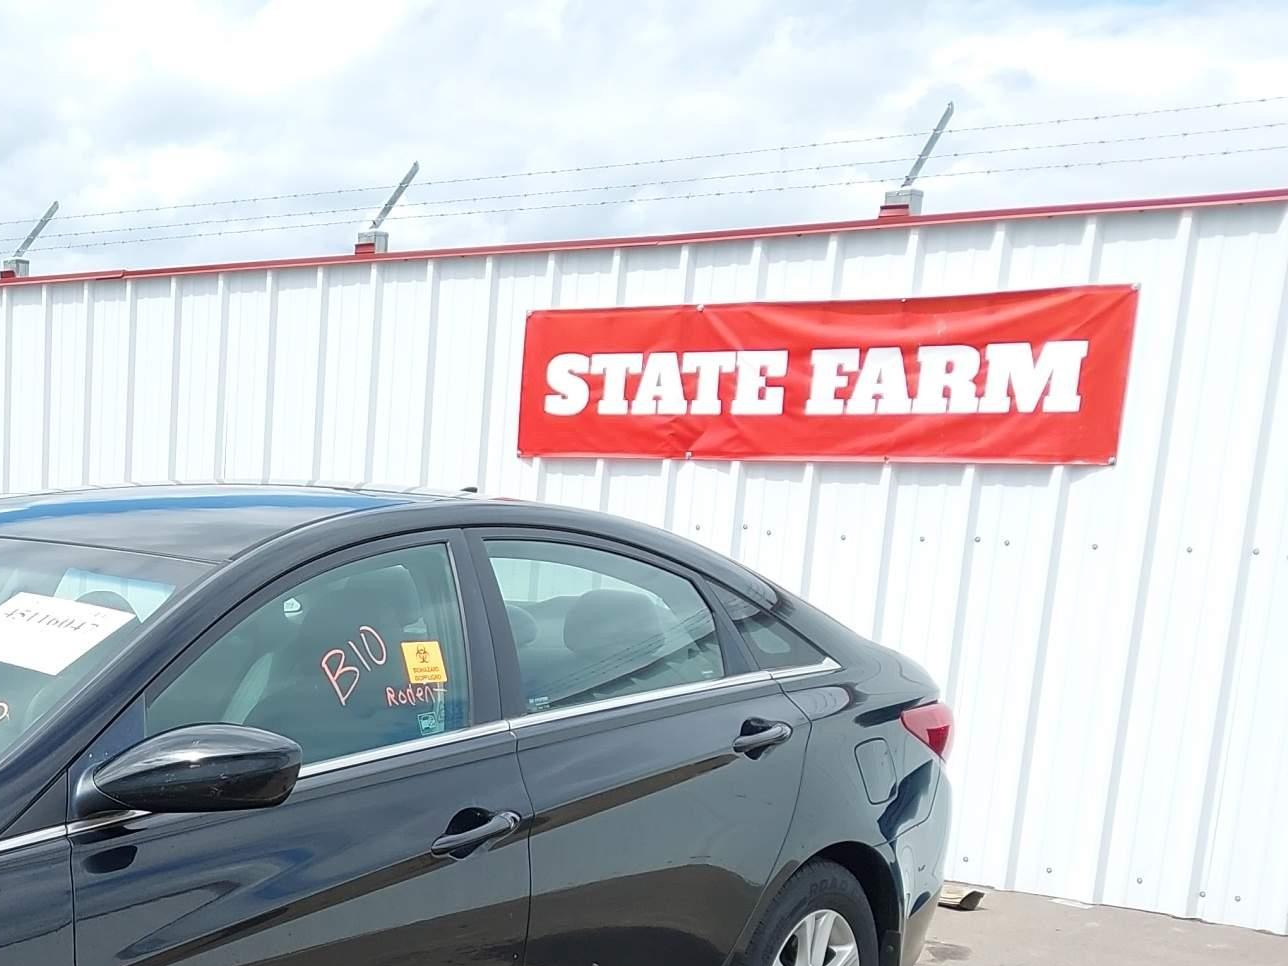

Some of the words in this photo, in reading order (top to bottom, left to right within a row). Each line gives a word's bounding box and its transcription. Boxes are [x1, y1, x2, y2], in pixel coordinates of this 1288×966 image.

[544, 350, 790, 416] STATE
[805, 340, 1089, 416] FARM
[321, 625, 387, 706] BIO
